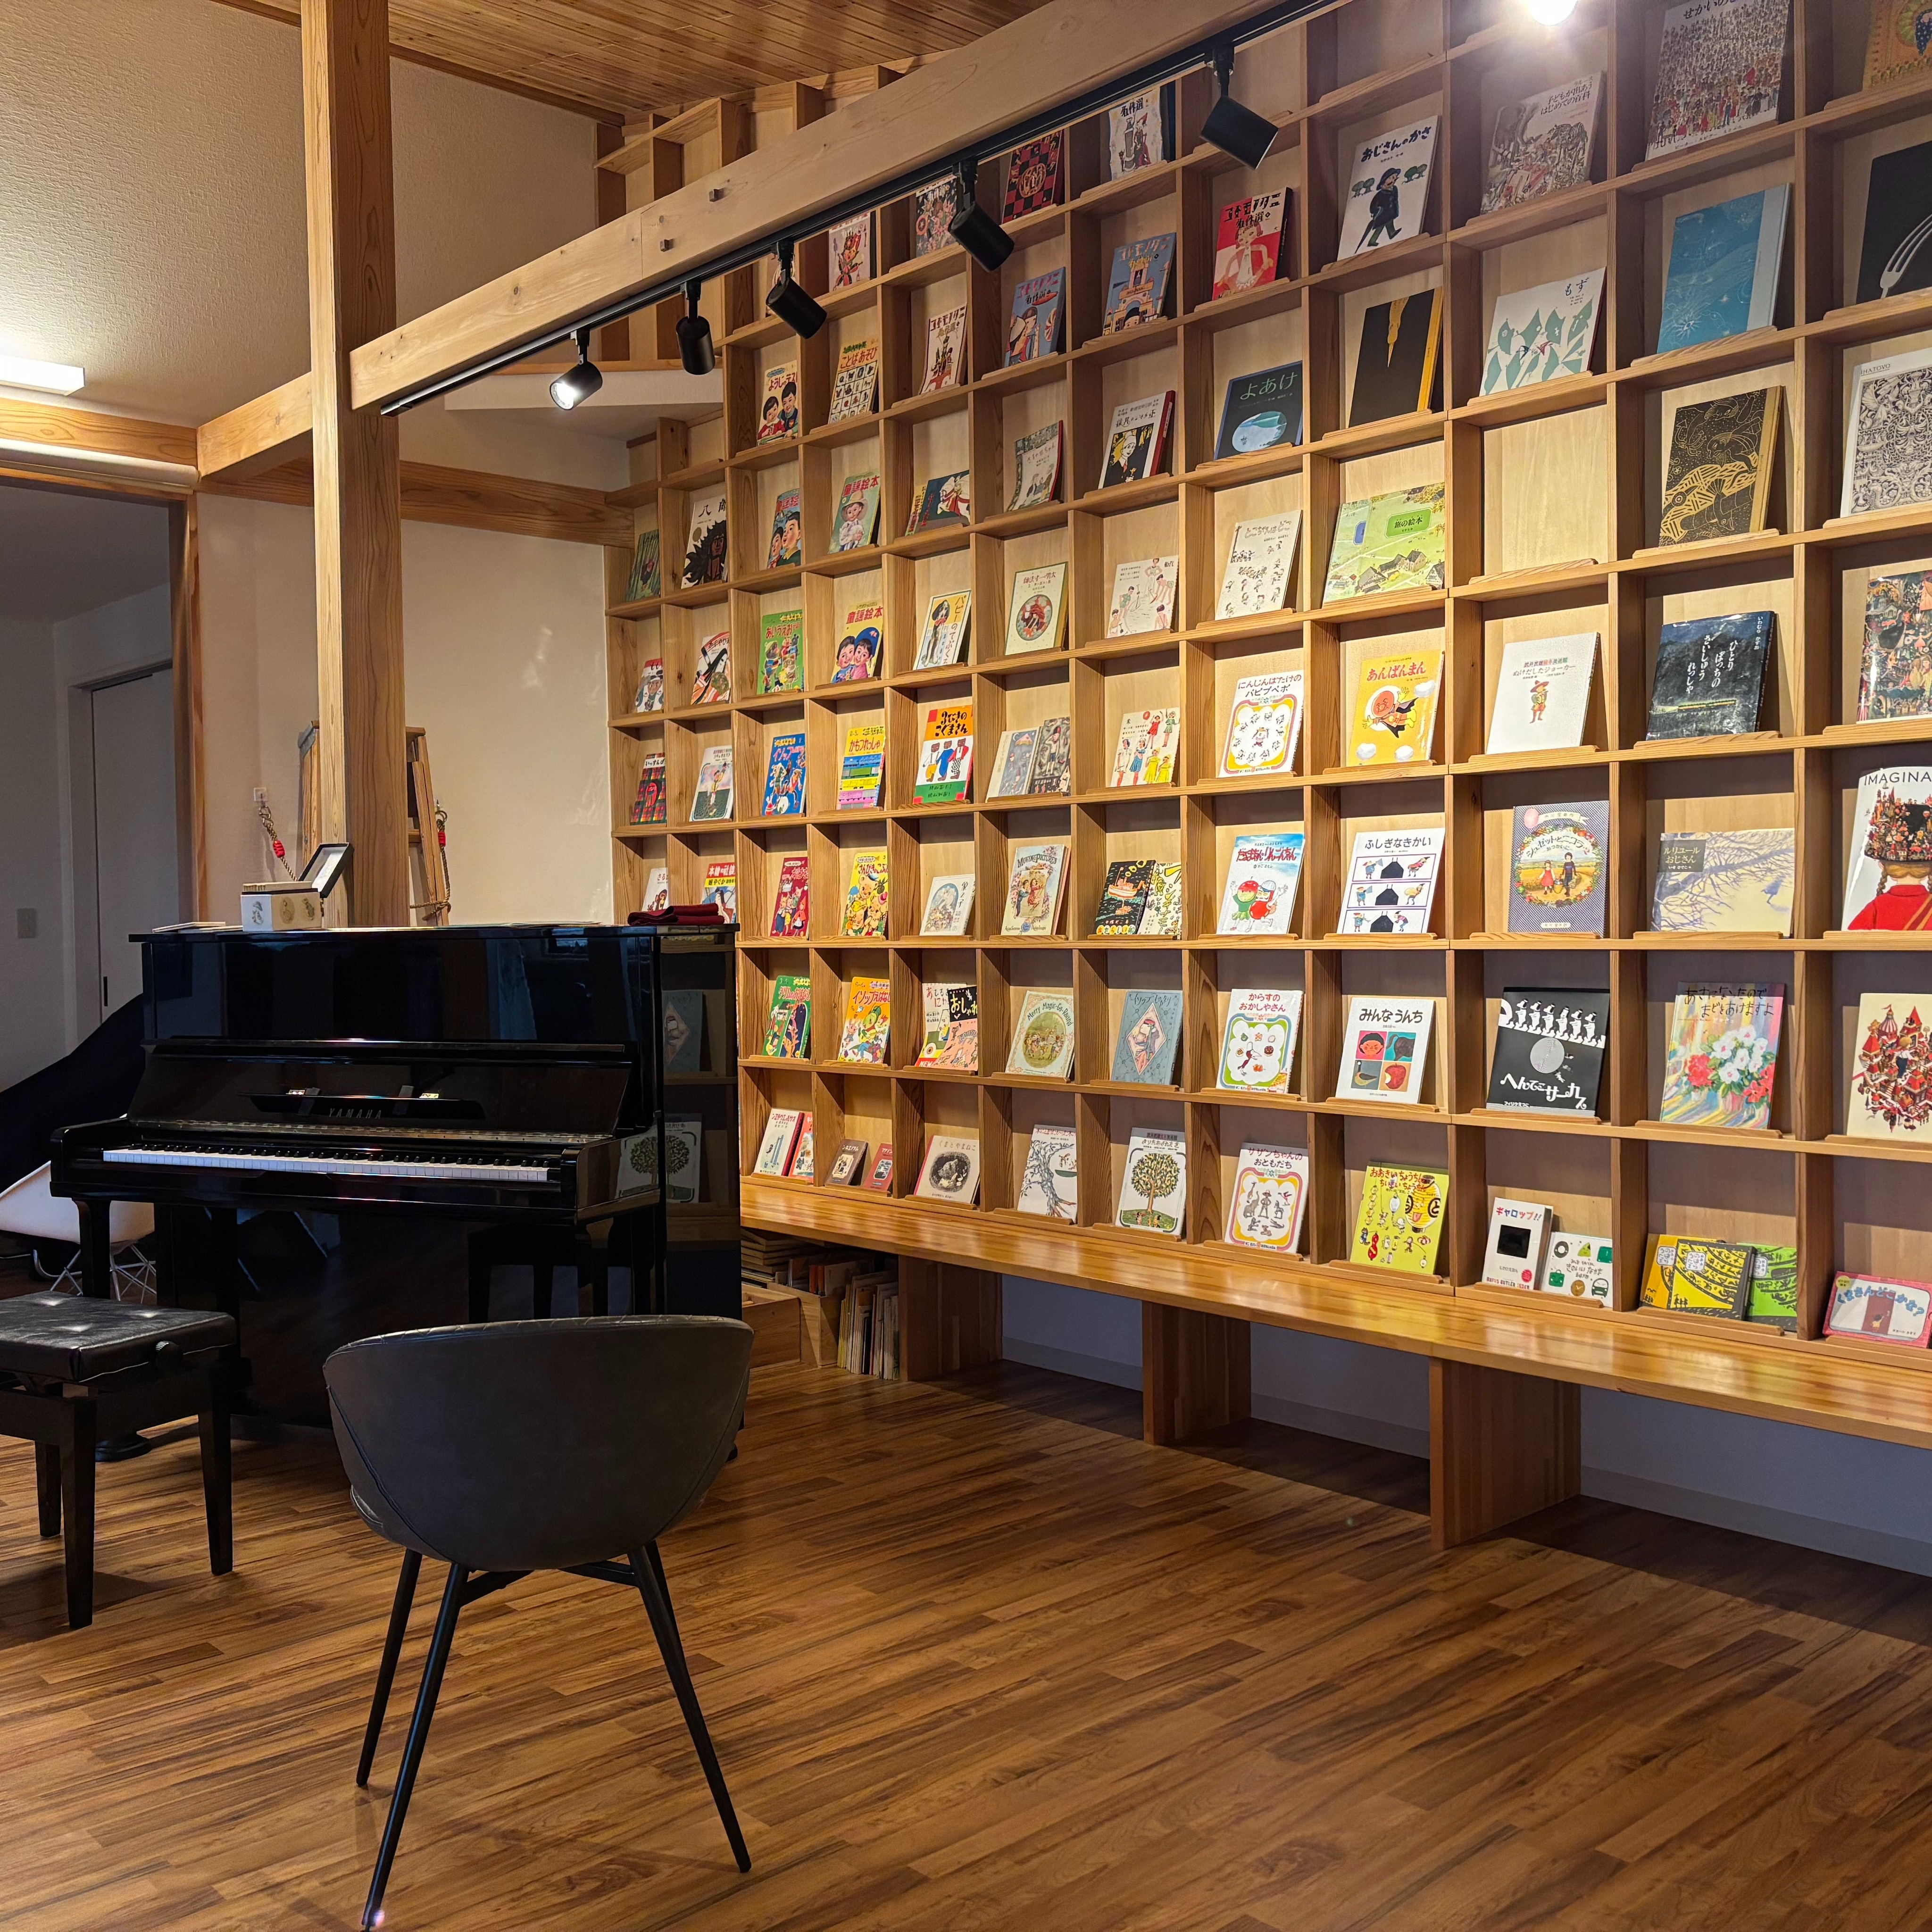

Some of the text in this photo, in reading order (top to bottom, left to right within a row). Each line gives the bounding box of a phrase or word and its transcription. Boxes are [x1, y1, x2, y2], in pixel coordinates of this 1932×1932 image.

[1361, 126, 1432, 163] おじさんのかさ
[1565, 277, 1590, 296] もず
[840, 346, 878, 369] ことばあそび
[1861, 363, 1890, 375] IHATOVO
[1240, 372, 1298, 400] よあけ
[1395, 516, 1422, 528] 旅の絵本
[1699, 635, 1713, 681] さいしゅう
[1729, 640, 1738, 671] ひとり
[1513, 665, 1576, 676] ぬけだしたジョーカー
[1712, 650, 1725, 688] ぼっちの
[1238, 675, 1301, 689] にんじんばたけの
[1686, 662, 1697, 693] れっしゃ
[935, 723, 968, 737] こぐまさん
[849, 737, 880, 752] かもつれっしゃ
[1865, 771, 1932, 785] IMAGINA
[1365, 837, 1431, 849] ふしぎなきかい
[1664, 847, 1701, 855] ルリユール
[1666, 855, 1696, 864] おじさん
[1249, 993, 1280, 1001] からすの
[1685, 986, 1767, 1005] あさになったので
[1027, 1006, 1041, 1021] Merry
[1239, 1003, 1286, 1012] おかしやさん
[1701, 1002, 1774, 1018] まどをあけますよ
[1359, 1008, 1423, 1024] みんなうんち
[329, 1108, 382, 1119] YAMAHA
[939, 1141, 975, 1151] くまとやまねこ
[1254, 1158, 1292, 1169] おともだち
[1496, 1206, 1542, 1221] ギャロップ!!
[1837, 1285, 1925, 1316] くまさんどこかな?
